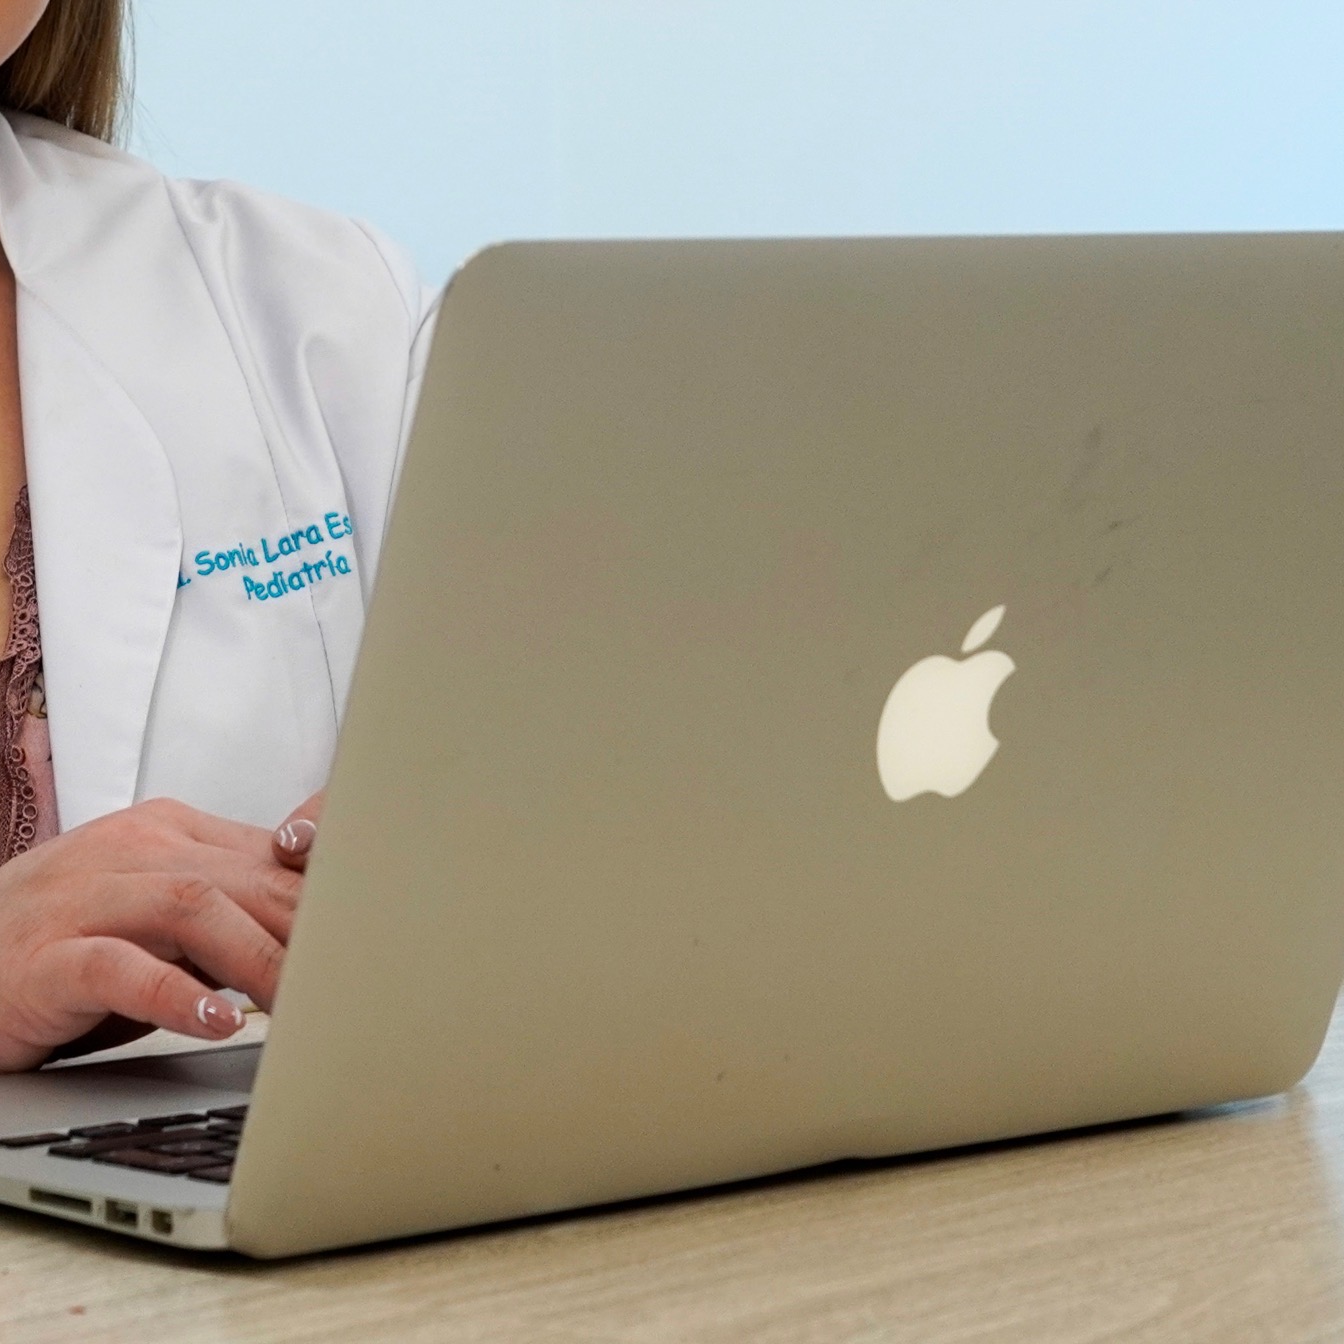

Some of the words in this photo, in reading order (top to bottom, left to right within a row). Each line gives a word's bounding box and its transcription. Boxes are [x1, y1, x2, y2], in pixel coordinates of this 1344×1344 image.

[194, 542, 259, 576] Sonia
[261, 524, 324, 563] Lara
[242, 549, 352, 601] Pediatría
